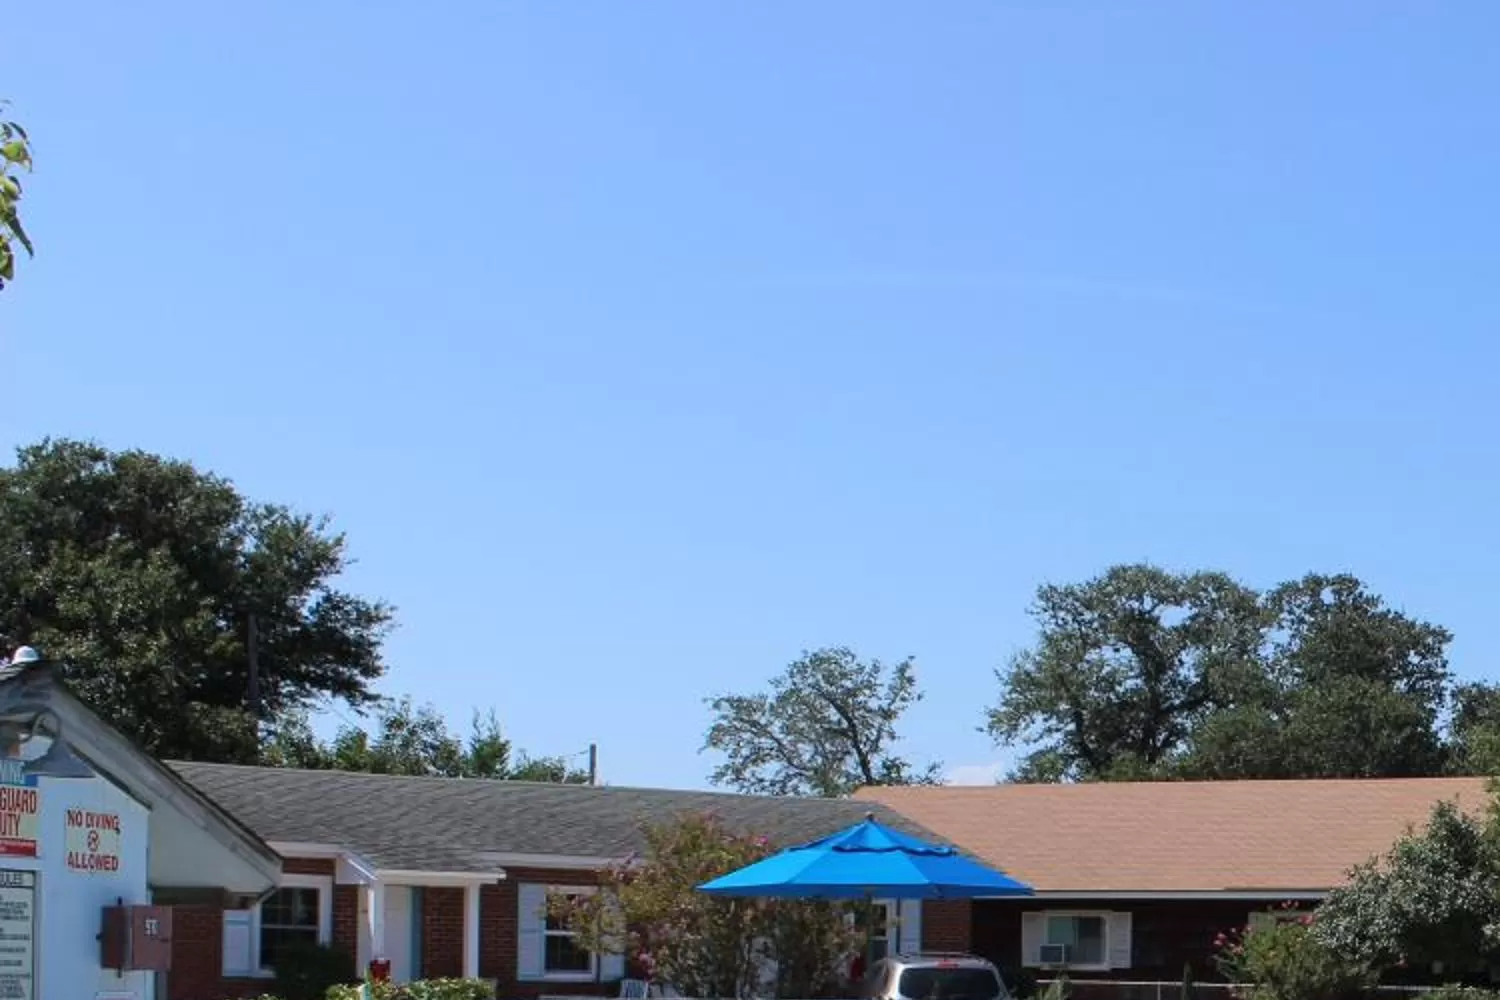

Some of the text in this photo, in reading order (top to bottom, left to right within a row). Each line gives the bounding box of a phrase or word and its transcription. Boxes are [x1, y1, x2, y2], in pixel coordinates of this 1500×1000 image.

[66, 810, 120, 831] NO DIVING
[66, 851, 119, 871] ALLOWED
